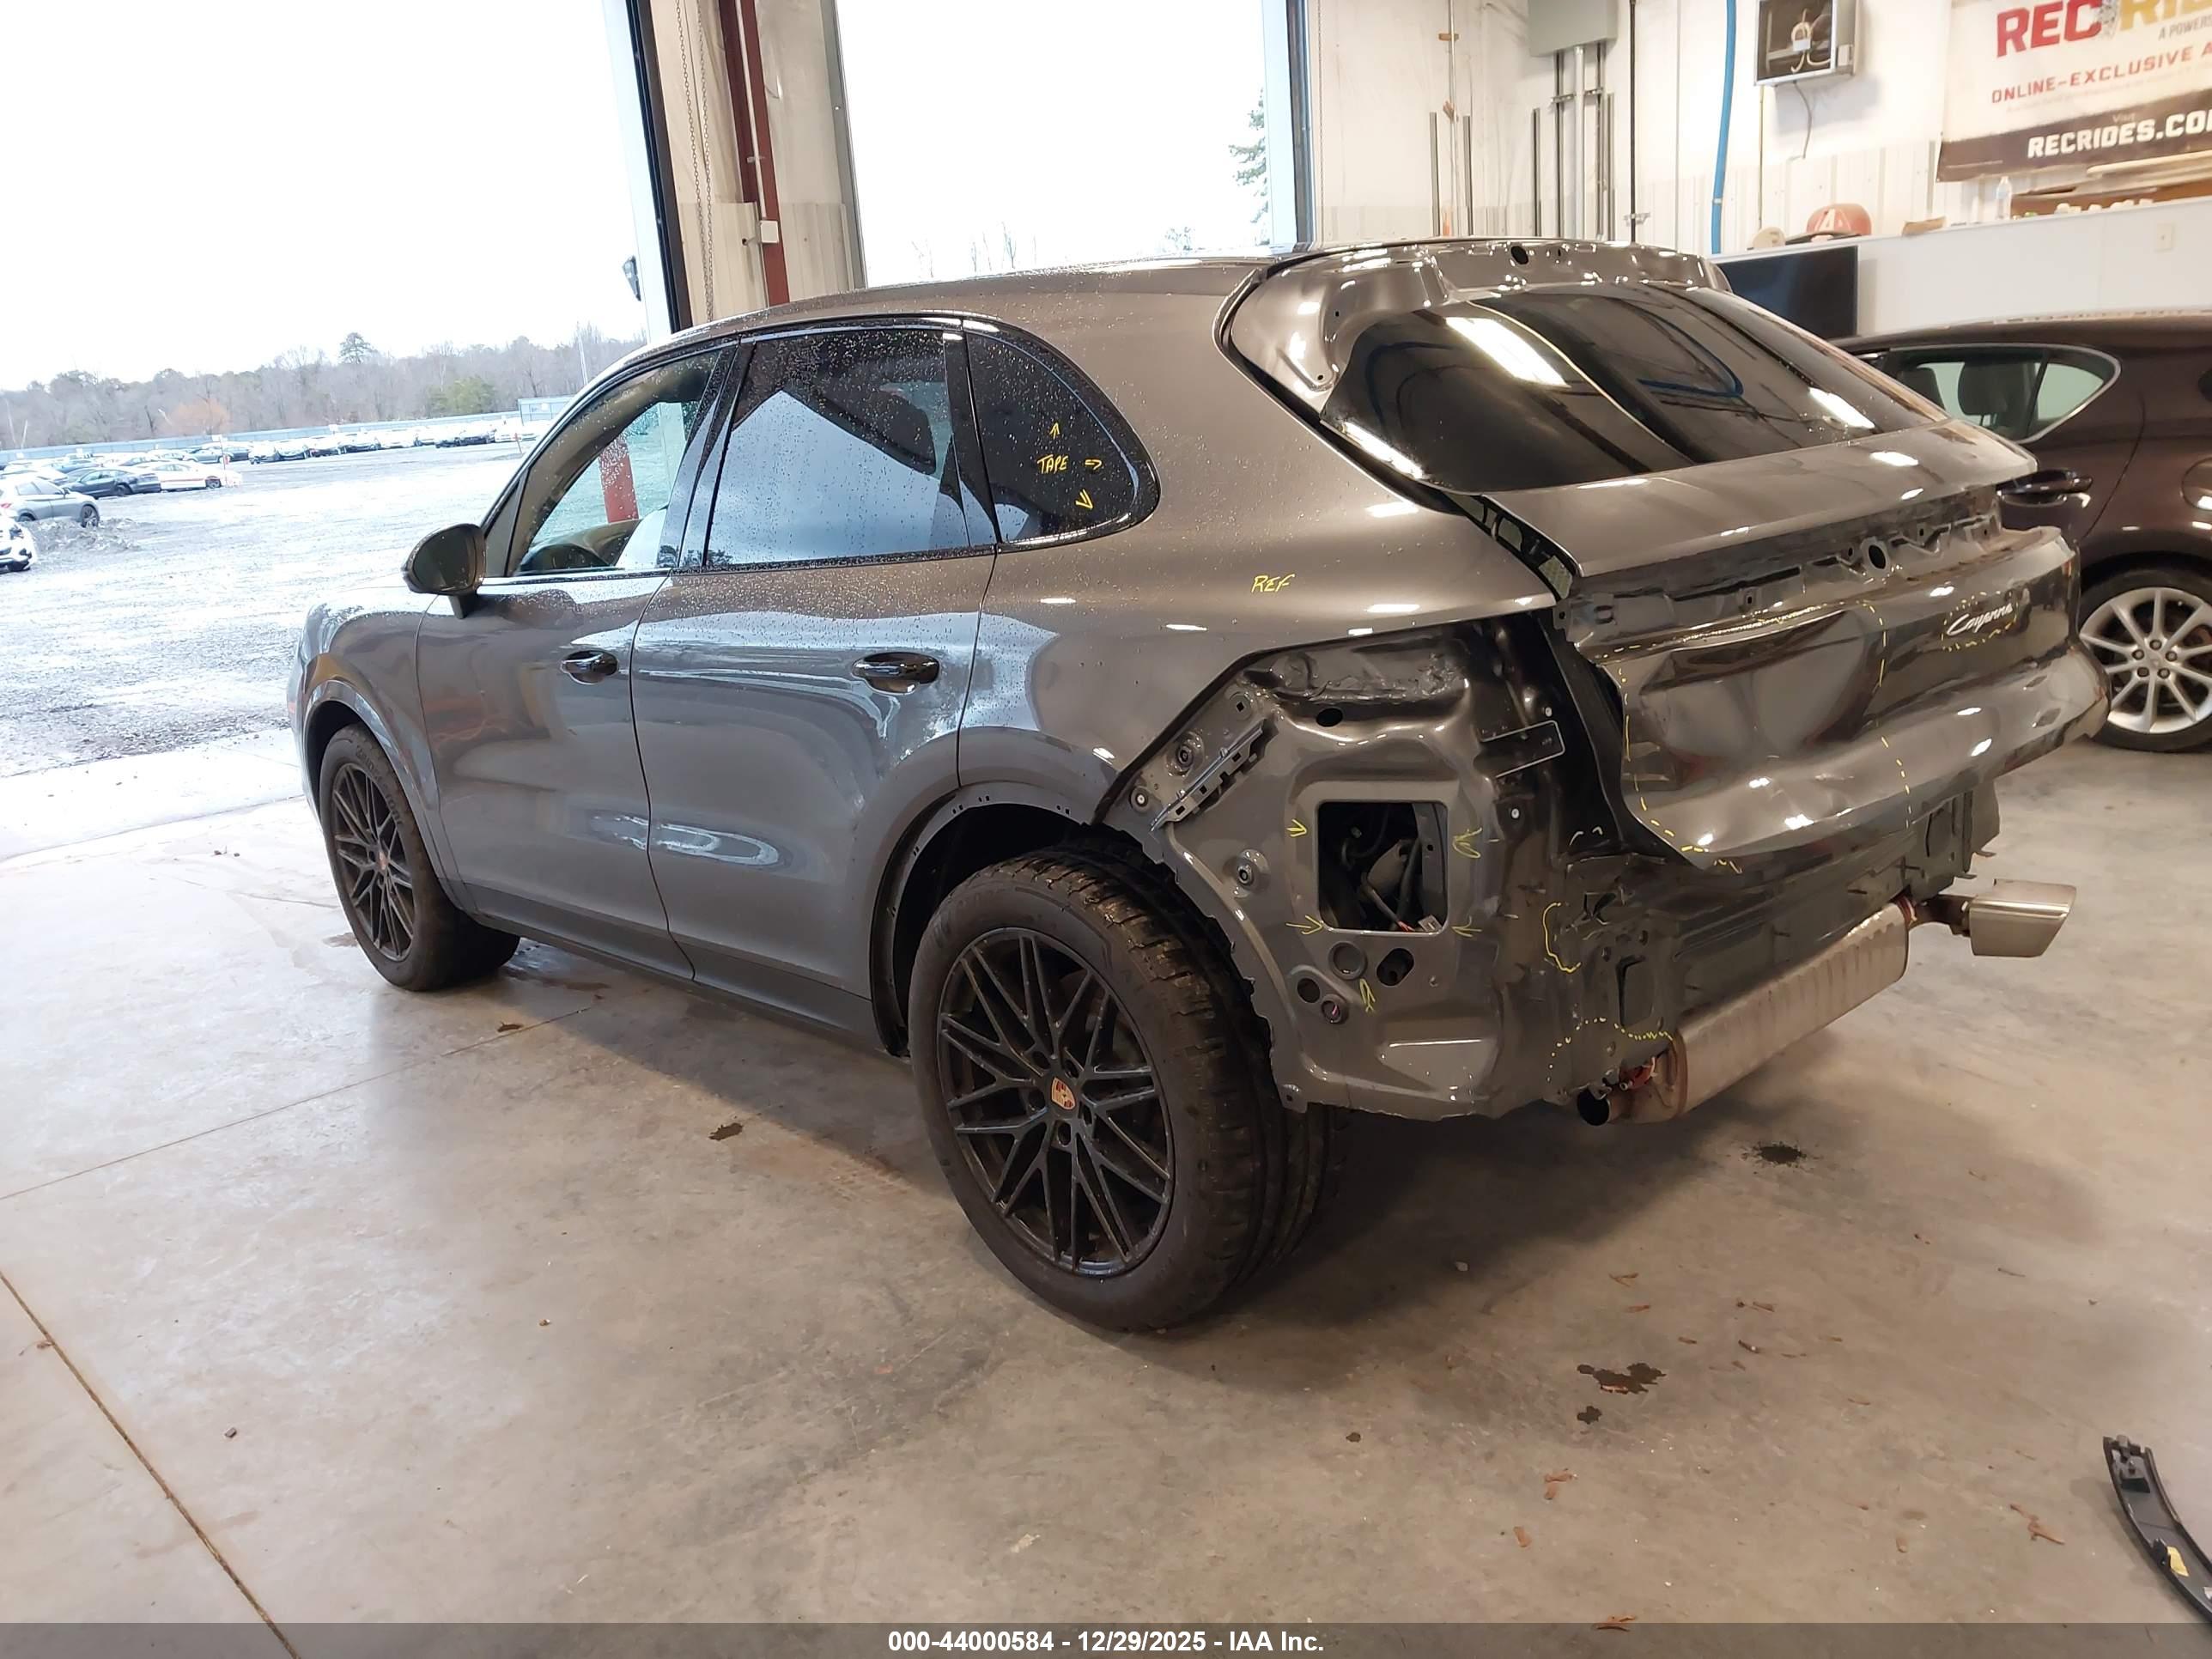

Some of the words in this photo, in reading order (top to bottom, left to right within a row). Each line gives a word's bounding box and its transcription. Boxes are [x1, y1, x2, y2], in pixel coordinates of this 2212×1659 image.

[1996, 0, 2102, 58] REC
[1991, 45, 2192, 103] ONLINE-EXCLUSIVE
[1037, 453, 1068, 474] TAPE
[1251, 574, 1295, 592] REF
